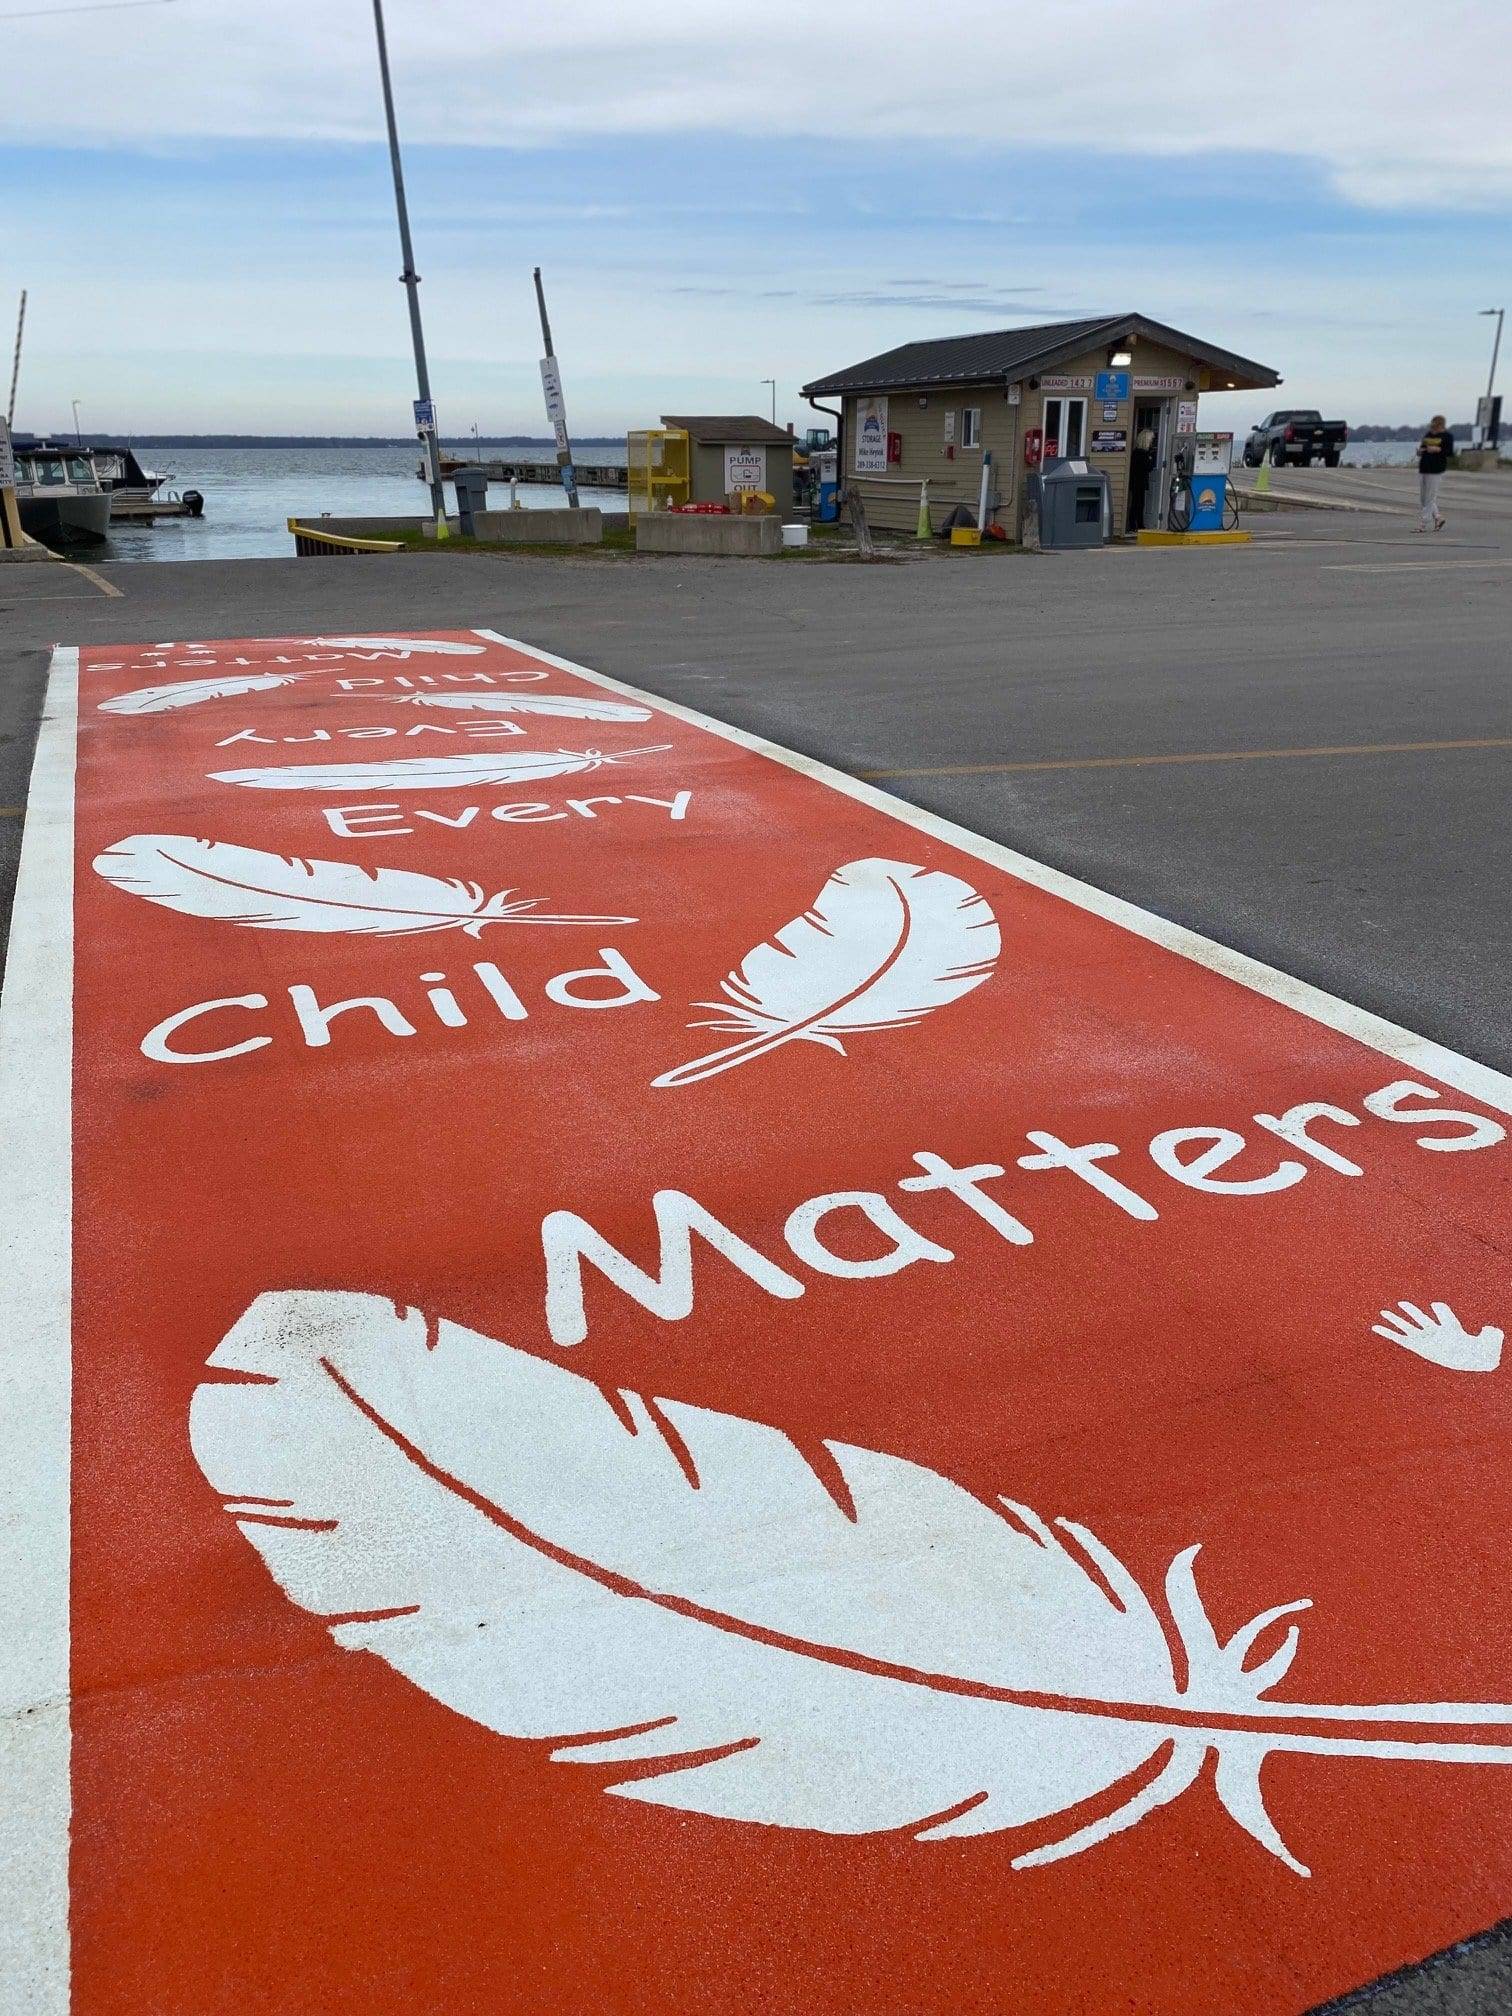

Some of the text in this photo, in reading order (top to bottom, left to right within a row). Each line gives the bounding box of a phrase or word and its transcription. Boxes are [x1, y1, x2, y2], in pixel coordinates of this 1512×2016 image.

[1042, 379, 1068, 387] UNLEADED
[1133, 378, 1158, 387] PREMIUM
[862, 434, 881, 443] STORAGE
[729, 456, 762, 465] PUMP
[86, 649, 413, 672] Matters
[335, 669, 549, 690] Child
[213, 719, 528, 747] Every
[322, 788, 694, 839] Every
[139, 945, 662, 1065] Child
[540, 1078, 1508, 1348] Matters
